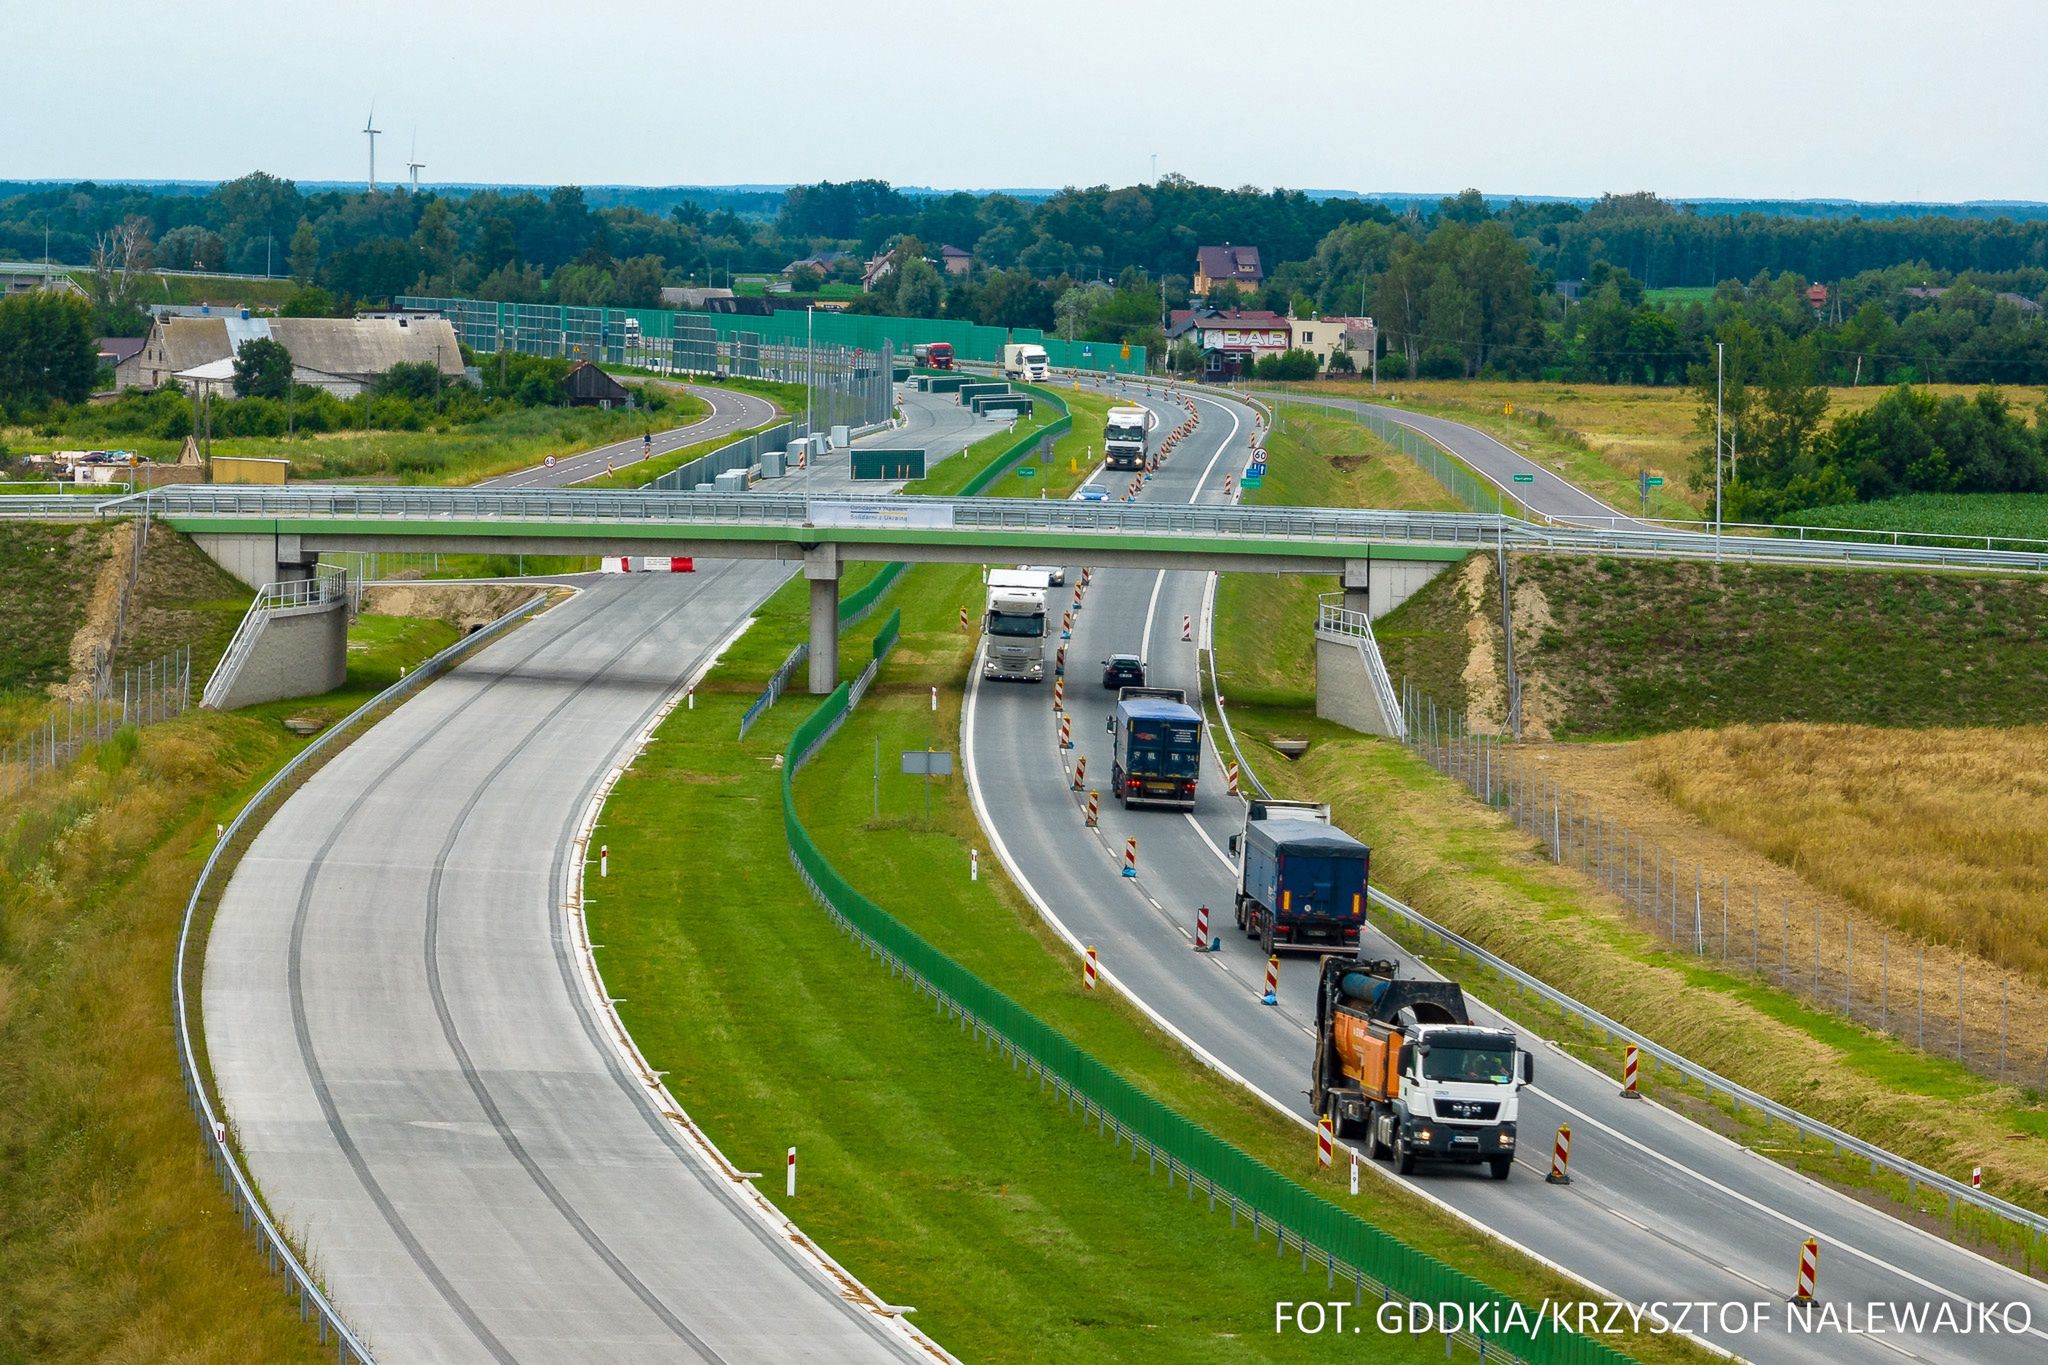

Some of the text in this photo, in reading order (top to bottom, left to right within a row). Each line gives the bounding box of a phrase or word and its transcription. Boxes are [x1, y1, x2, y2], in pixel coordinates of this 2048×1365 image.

[1223, 329, 1287, 346] BAR
[1255, 450, 1266, 460] 60
[1452, 1104, 1482, 1113] MAN
